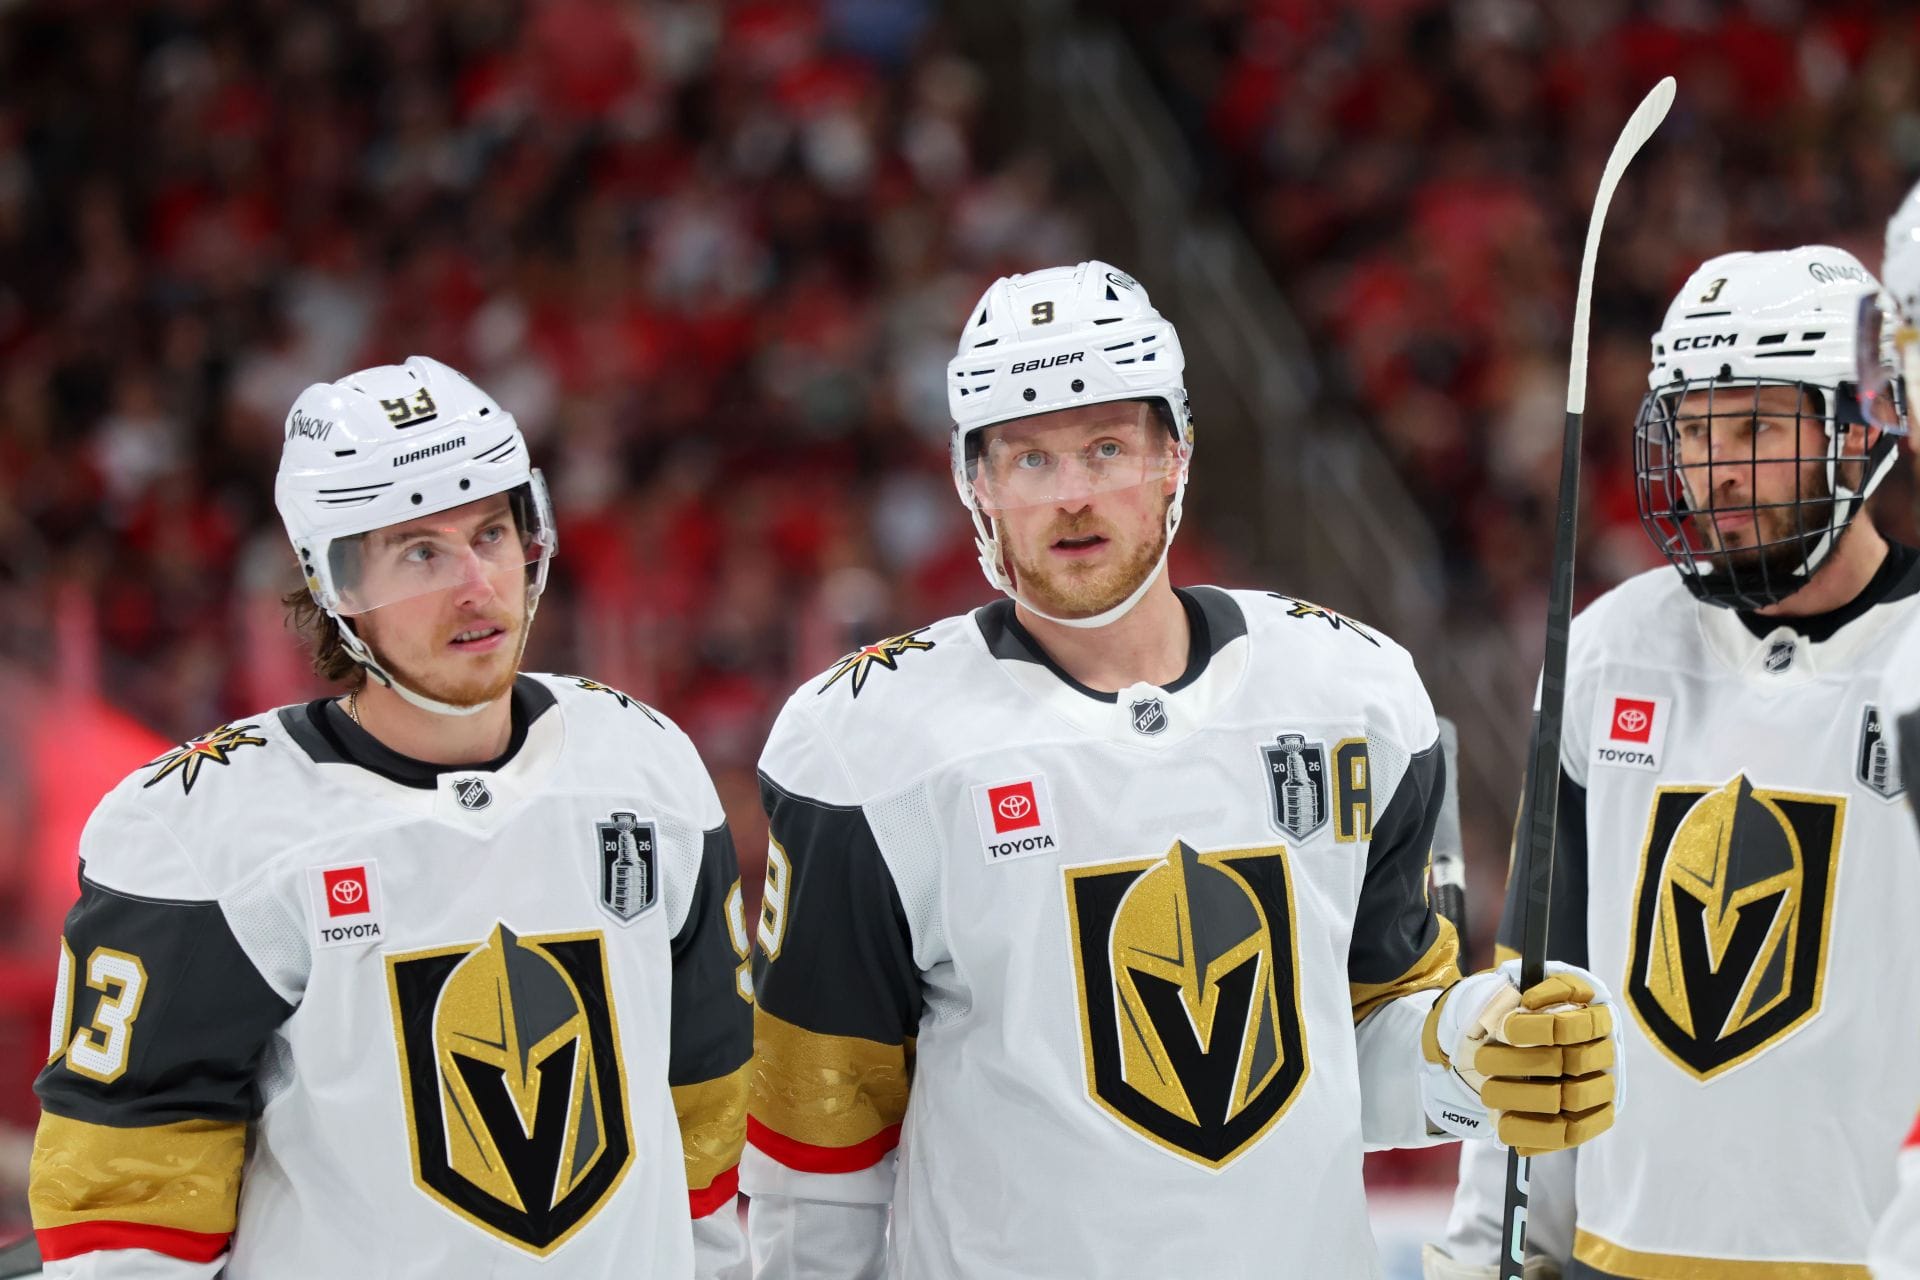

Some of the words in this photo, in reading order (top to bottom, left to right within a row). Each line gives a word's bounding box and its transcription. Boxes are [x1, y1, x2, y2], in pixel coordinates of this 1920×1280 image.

[1701, 278, 1728, 303] 3
[1031, 301, 1054, 326] 9
[1673, 333, 1739, 351] CCM
[379, 386, 438, 424] 93
[393, 436, 466, 468] WARRIOR
[1140, 706, 1160, 730] NHL
[1272, 762, 1285, 774] 20
[1308, 761, 1321, 773] 26
[1597, 749, 1655, 767] TOYOTA
[464, 785, 482, 806] NHL
[1331, 737, 1373, 843] A
[605, 841, 617, 852] 20
[639, 840, 651, 852] 26
[988, 834, 1055, 858] TOYOTA
[321, 923, 381, 943] TOYOTA
[1442, 1110, 1480, 1129] MACH
